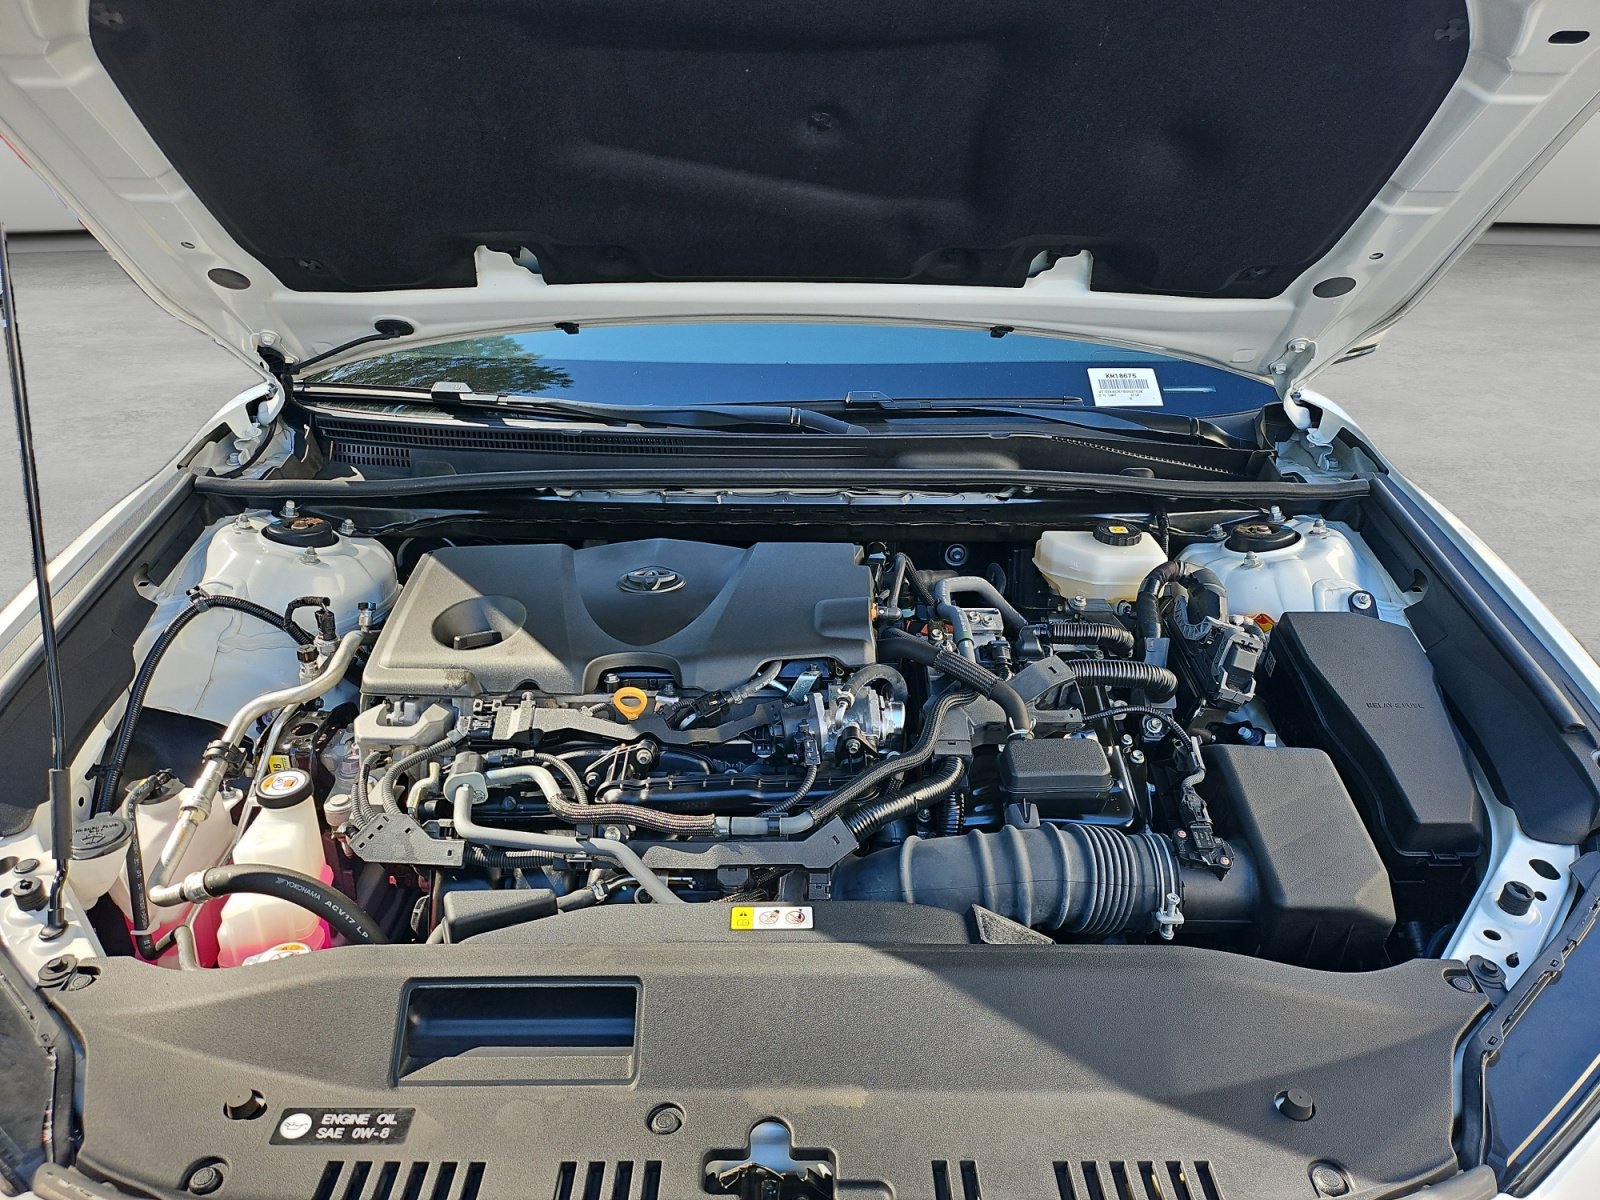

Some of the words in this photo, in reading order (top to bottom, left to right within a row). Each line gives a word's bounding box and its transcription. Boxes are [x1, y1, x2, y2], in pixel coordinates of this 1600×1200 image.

[286, 880, 321, 900] YOKOHAMA
[324, 900, 356, 924] ACV17
[356, 926, 369, 938] LP
[321, 1113, 371, 1125] ENGINE
[376, 1113, 398, 1125] OIL
[315, 1127, 345, 1139] SAE
[351, 1127, 391, 1139] 0W-8
